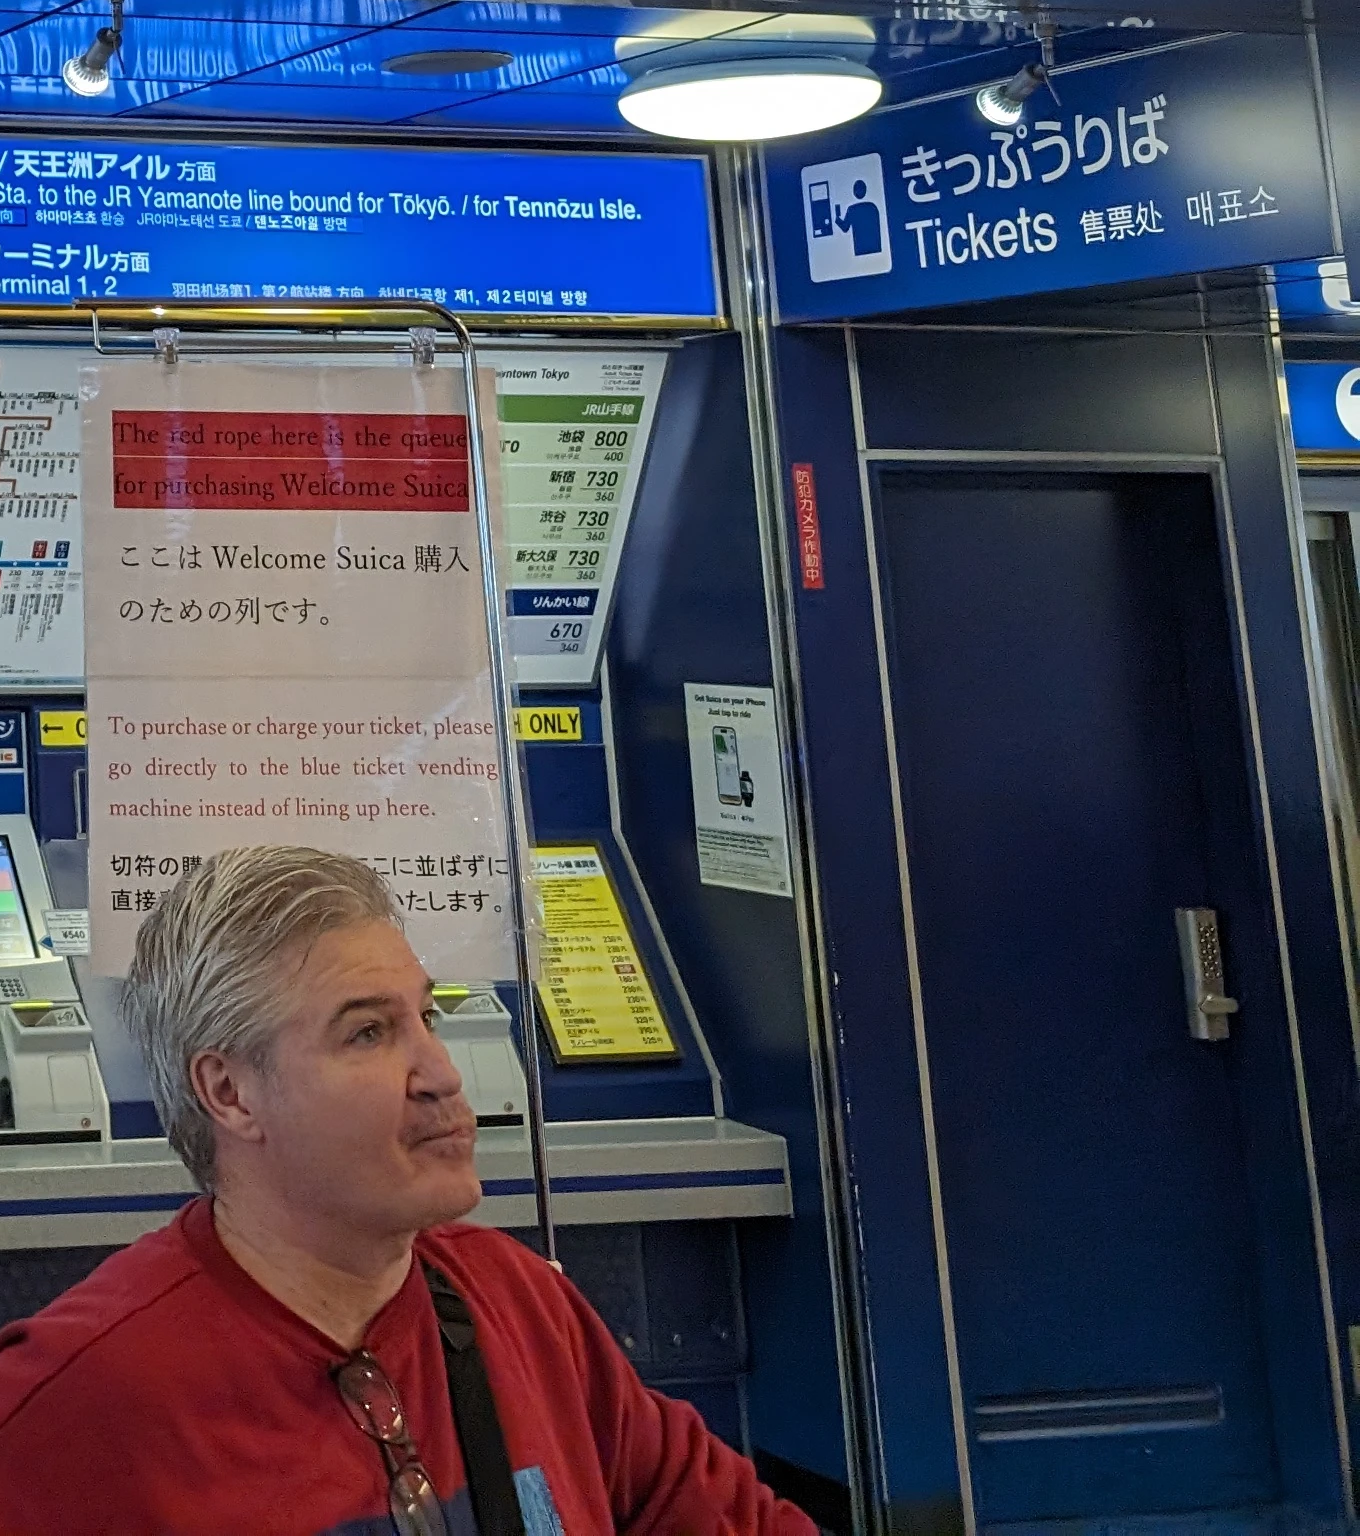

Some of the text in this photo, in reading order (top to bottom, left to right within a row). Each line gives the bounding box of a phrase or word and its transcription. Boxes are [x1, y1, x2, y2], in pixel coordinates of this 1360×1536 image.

[901, 92, 1170, 204] きっぷうりば
[13, 150, 170, 180] 天王洲アイル
[177, 161, 215, 182] 方面
[38, 185, 58, 205] to
[64, 184, 96, 206] the
[103, 186, 131, 206] JR
[138, 186, 242, 210] Yamanote
[249, 189, 283, 211] line
[290, 190, 351, 212] bound
[357, 192, 384, 213] for
[473, 195, 499, 216] for
[504, 196, 593, 218] Tennōzu
[600, 199, 641, 219] Isle.
[1187, 186, 1279, 226] 매표소
[1080, 200, 1164, 244] 售票处
[906, 208, 1057, 268] Tickets
[77, 276, 96, 297] 1,
[104, 276, 117, 295] 2
[114, 422, 467, 452] The red rope here is the queue
[595, 431, 627, 446] 800
[114, 473, 468, 501] for purchasing Welcome Suica
[588, 471, 618, 486] 730
[122, 545, 469, 573] ここは Welcome Suica 購入
[120, 597, 328, 625] のための列です。
[551, 623, 582, 638] 670
[108, 716, 493, 742] To purchase or charge your ticket, please
[109, 757, 498, 780] go directly to the blue ticket vending
[110, 797, 435, 823] machine instead of lining up here.
